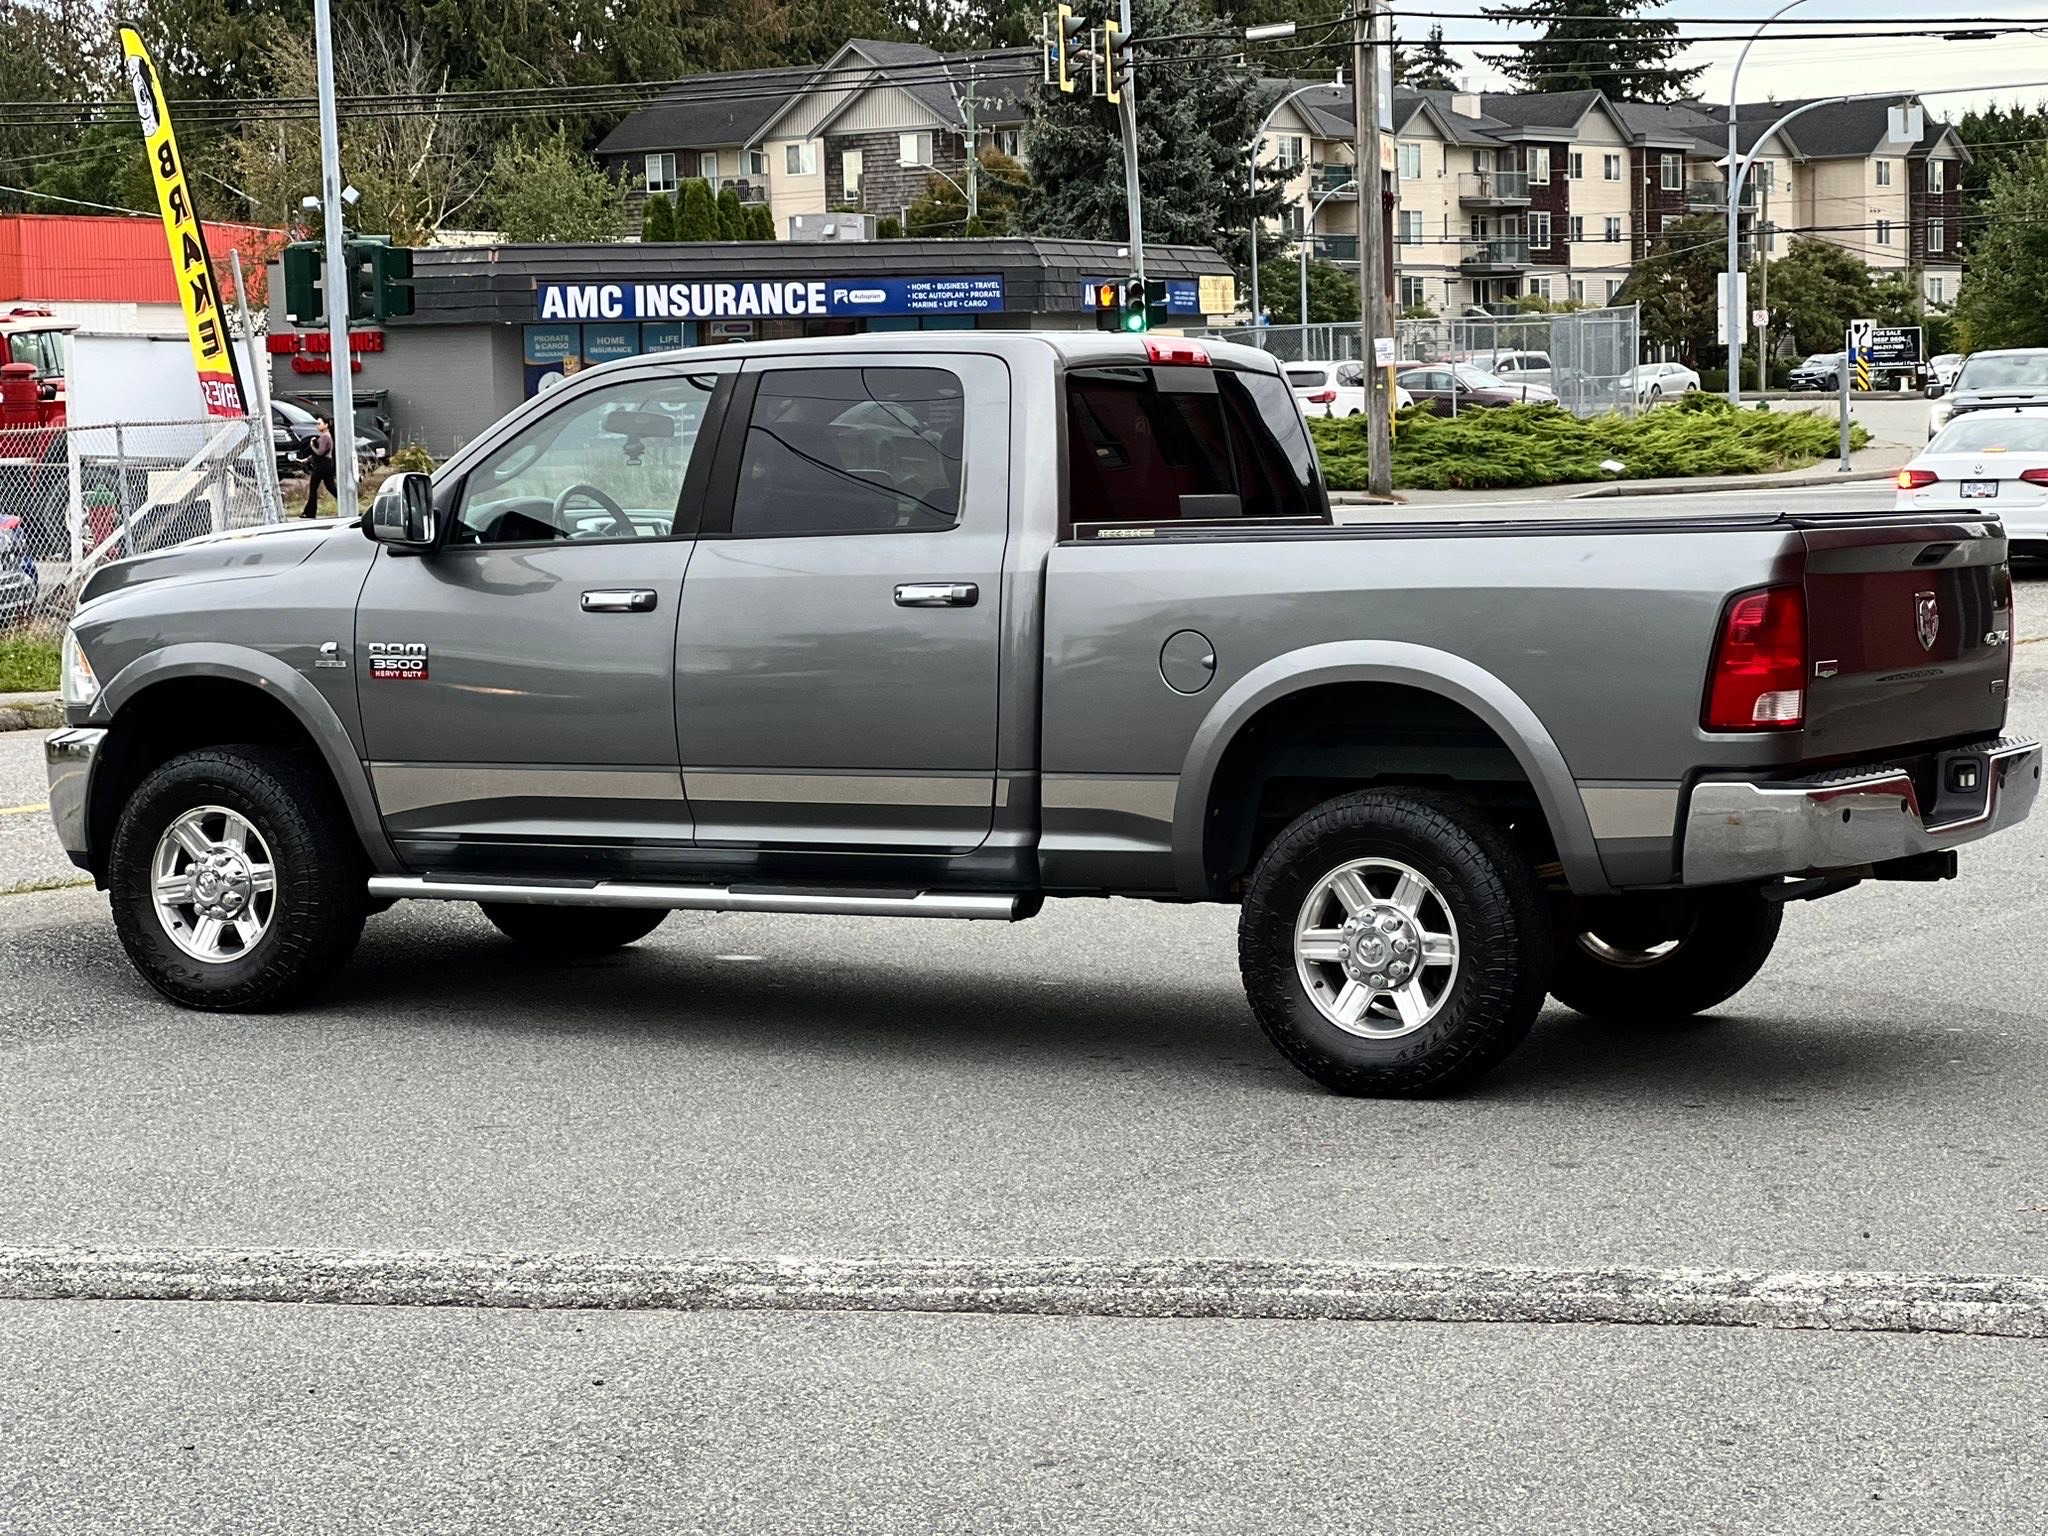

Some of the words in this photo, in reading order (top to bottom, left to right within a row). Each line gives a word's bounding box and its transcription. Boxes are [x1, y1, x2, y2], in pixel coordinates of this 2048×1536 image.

[929, 291, 965, 299] AUTOPLAN
[970, 290, 1001, 298] PRORATE
[541, 284, 623, 319] AMC
[634, 282, 827, 317] INSURANCE
[963, 299, 988, 307] CARGO
[596, 336, 625, 345] HOME
[659, 335, 680, 343] LIFE
[368, 642, 427, 660] RAM
[373, 660, 423, 669] 3500
